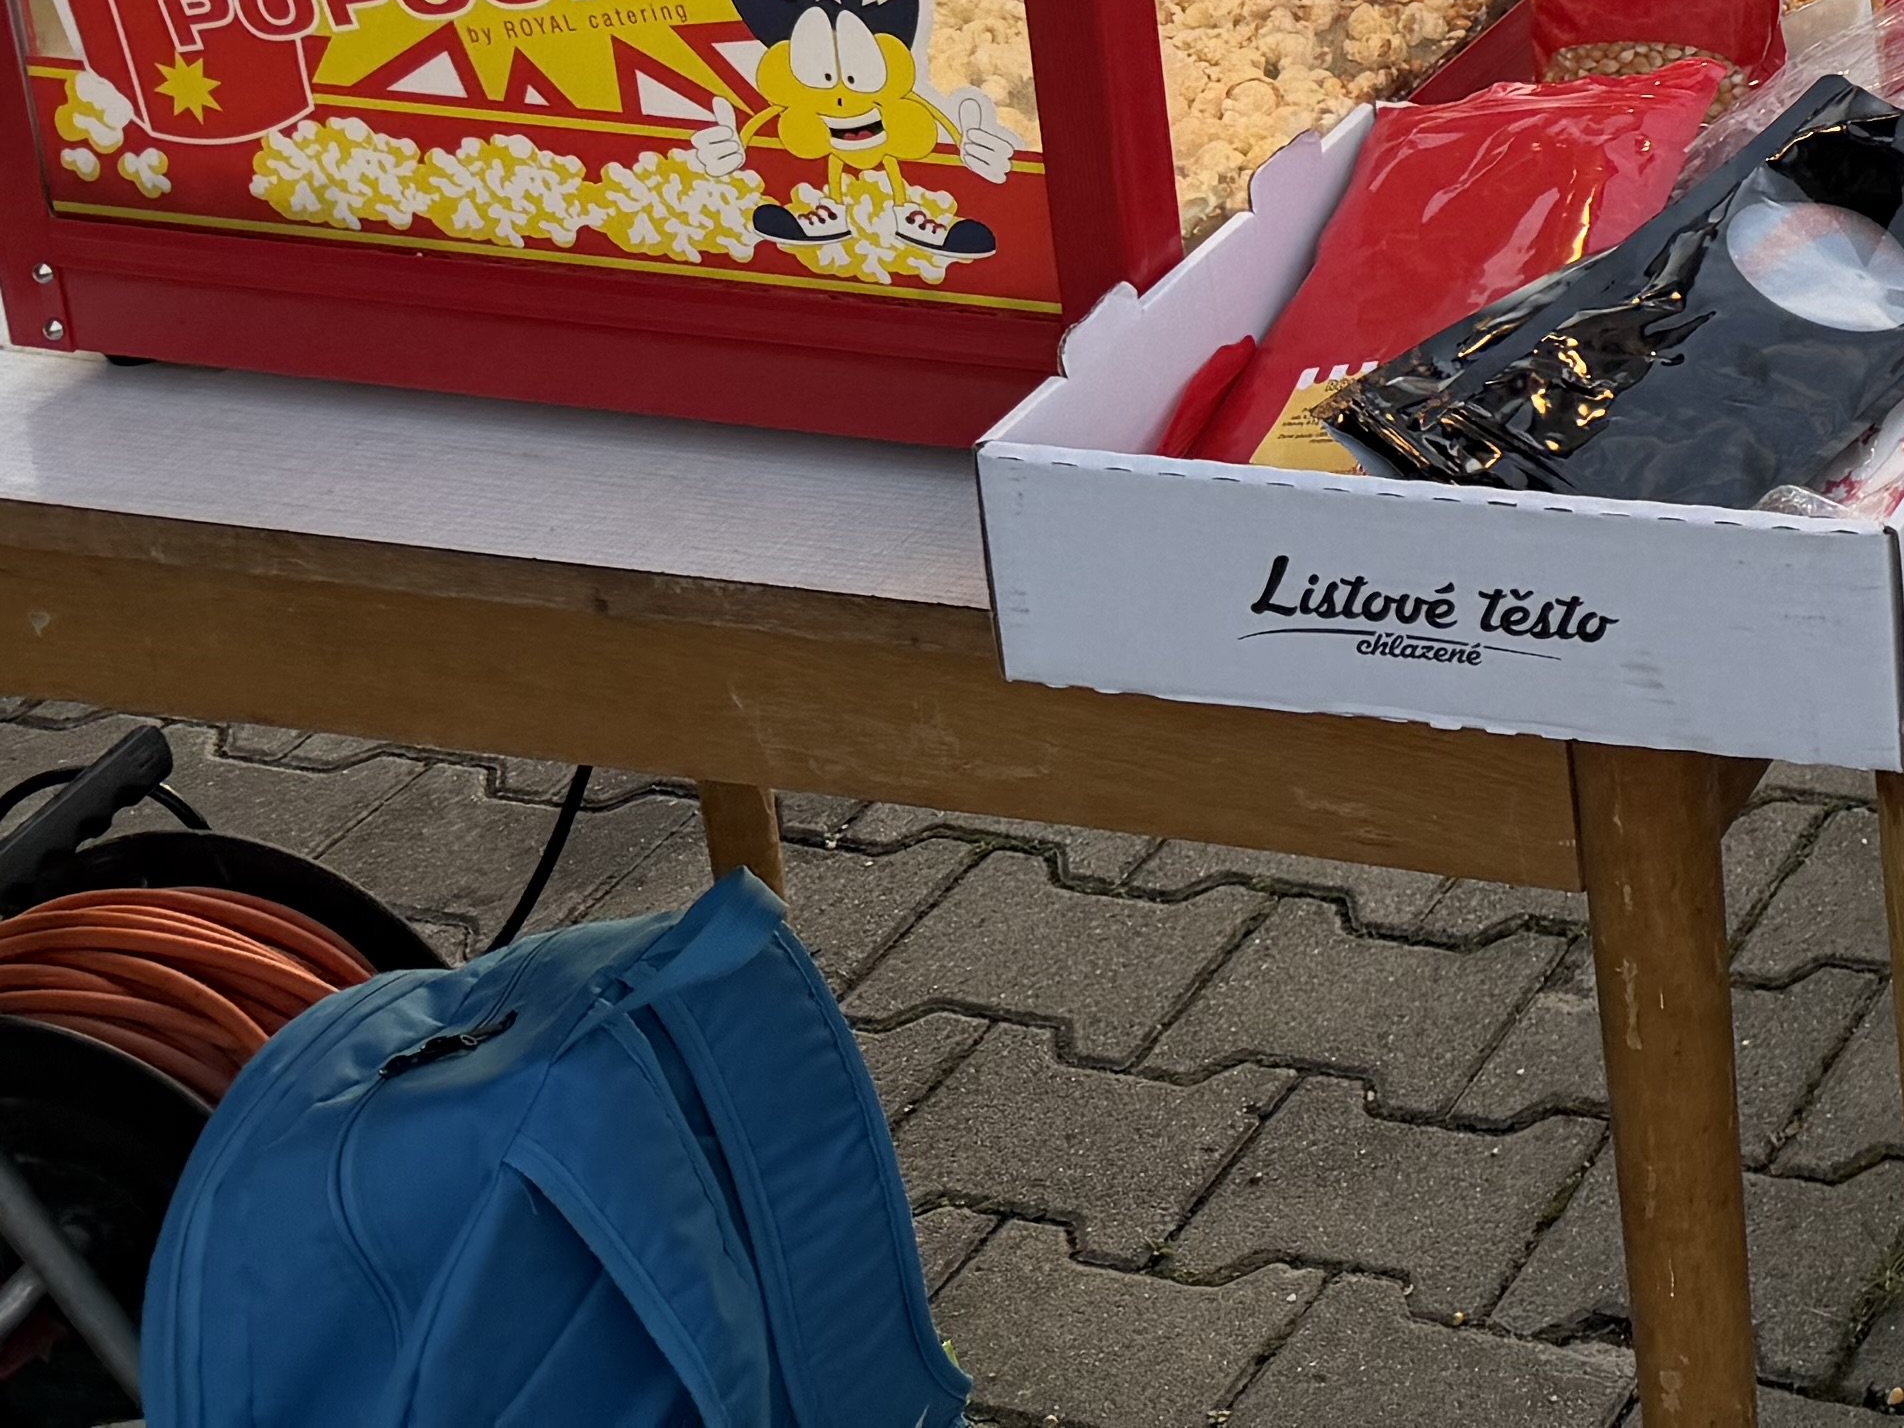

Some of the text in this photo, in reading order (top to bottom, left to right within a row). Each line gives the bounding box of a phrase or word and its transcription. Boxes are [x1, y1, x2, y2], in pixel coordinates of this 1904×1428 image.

[466, 4, 688, 46] by ROYAL catering
[1250, 555, 1620, 643] Listové těsto
[1356, 633, 1483, 667] chlazené
